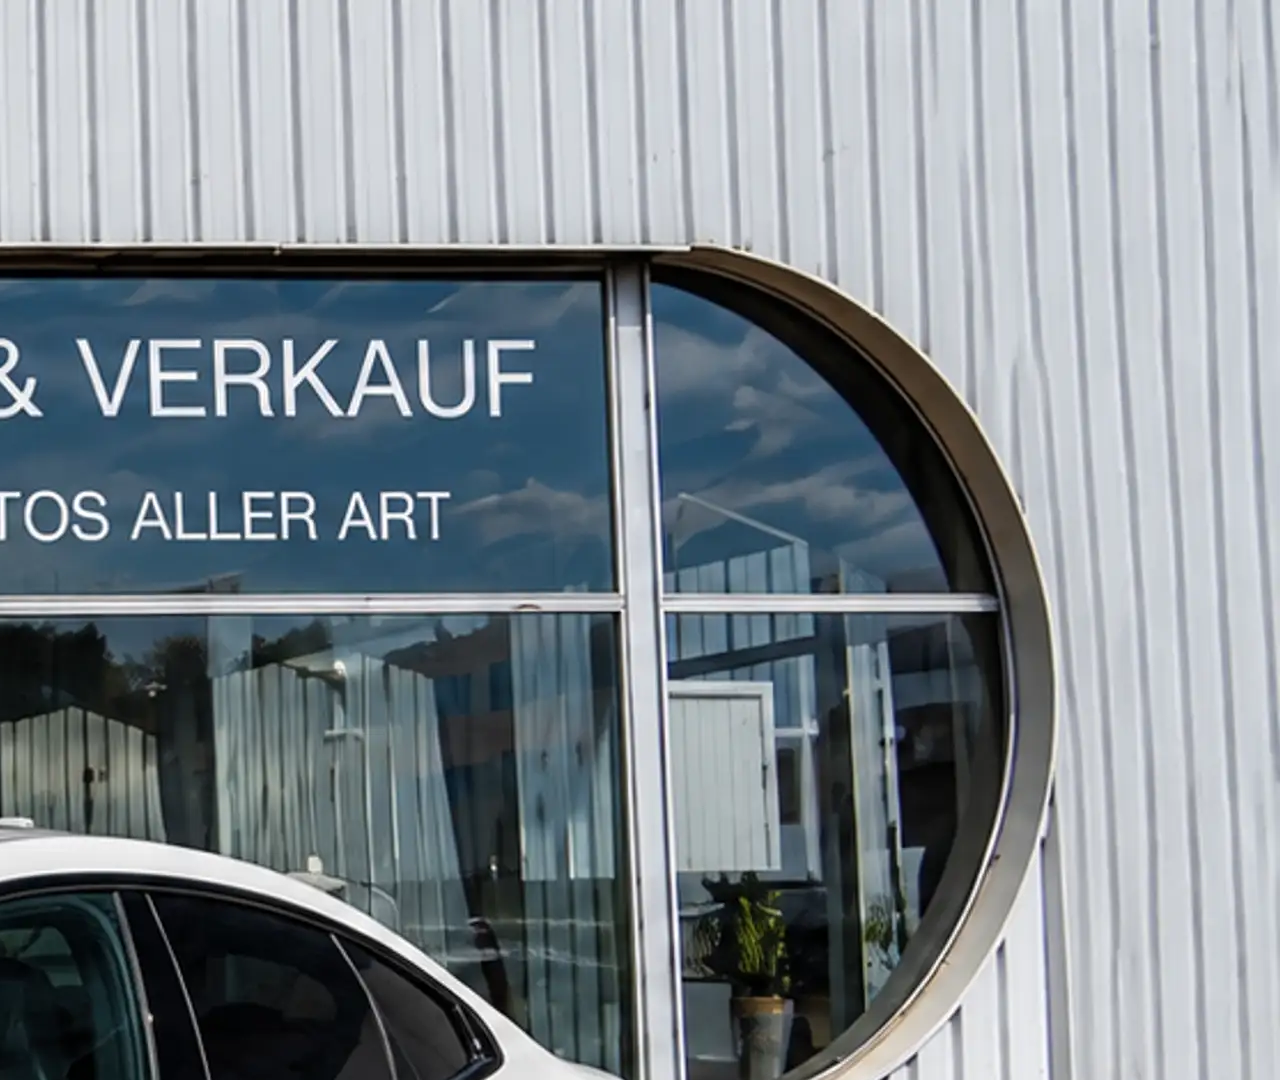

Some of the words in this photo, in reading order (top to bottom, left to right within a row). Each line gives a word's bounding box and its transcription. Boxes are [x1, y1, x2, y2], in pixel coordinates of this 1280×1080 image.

[75, 338, 537, 419] VERKAUF
[130, 489, 318, 542] ALLER
[337, 489, 452, 542] ART
